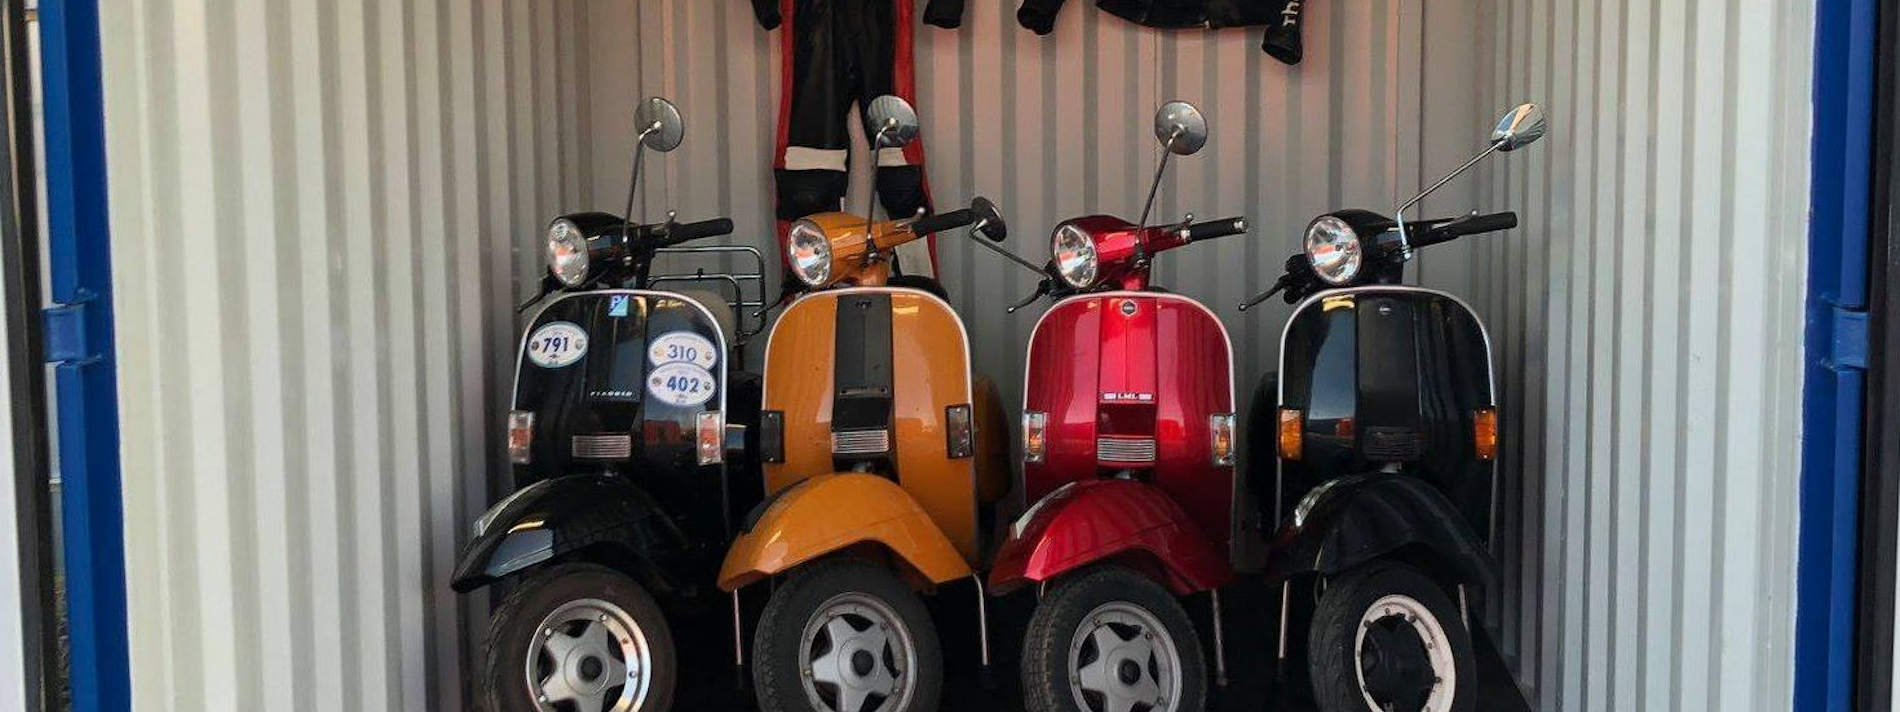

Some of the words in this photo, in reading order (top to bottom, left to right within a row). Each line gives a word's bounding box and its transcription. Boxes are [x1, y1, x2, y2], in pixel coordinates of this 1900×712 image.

[542, 337, 569, 353] 791
[667, 344, 697, 361] 310
[667, 376, 699, 393] 402
